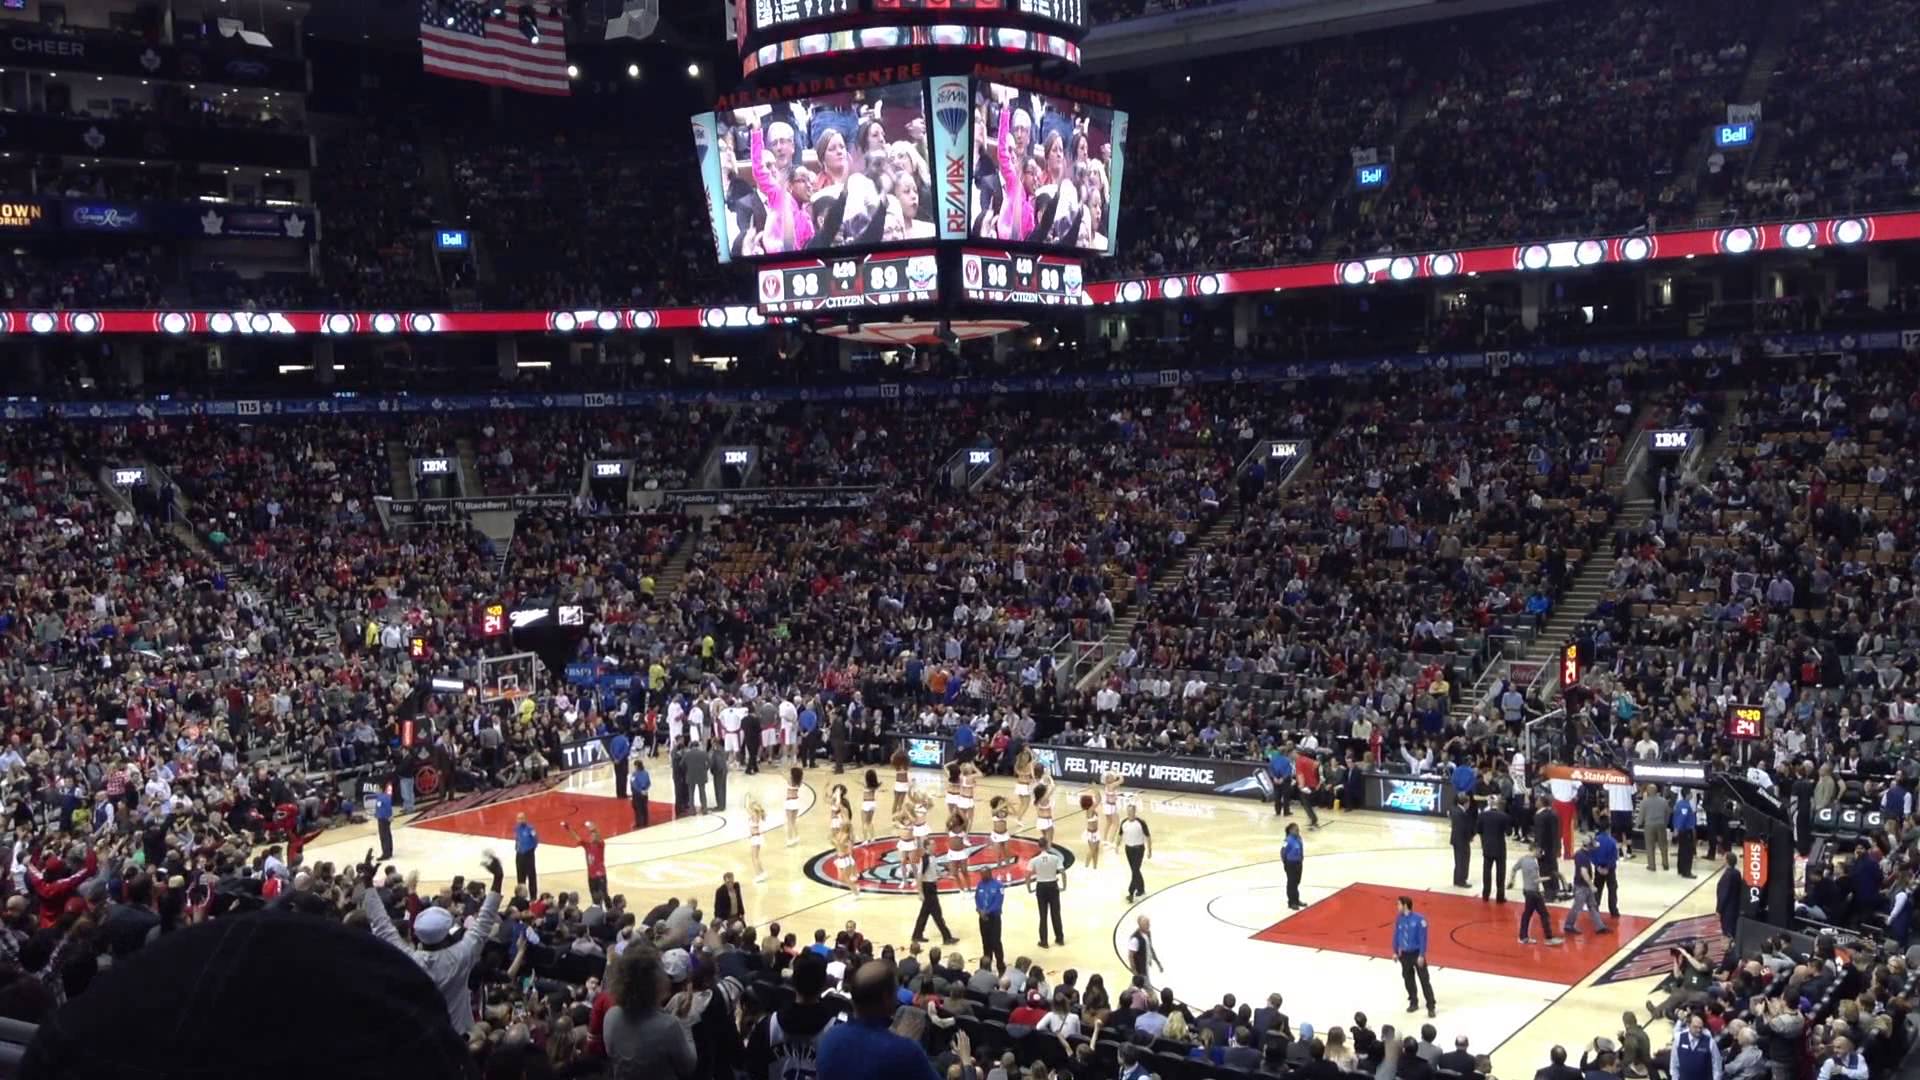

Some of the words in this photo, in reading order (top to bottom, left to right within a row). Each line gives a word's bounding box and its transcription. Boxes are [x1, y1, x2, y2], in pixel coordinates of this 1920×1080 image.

[12, 38, 84, 56] CHEER
[715, 90, 752, 110] AIR
[756, 78, 836, 101] CANADA
[844, 63, 922, 88] CENTRE
[1721, 126, 1746, 143] Bell
[1361, 169, 1381, 183] Bell
[945, 153, 967, 232] RE/MAX
[442, 233, 461, 245] Bell
[792, 273, 819, 296] 98
[871, 265, 898, 290] 89
[825, 295, 864, 309] CITIZEN
[239, 401, 258, 414] 115
[585, 395, 604, 406] 116
[1655, 432, 1687, 447] IBM
[969, 451, 990, 463] IBM
[1271, 443, 1297, 457] IBM
[725, 451, 748, 464] IBM
[422, 460, 448, 472] IBM
[596, 463, 621, 475] IBM
[116, 471, 142, 484] IBM
[485, 616, 500, 632] 24
[1736, 719, 1755, 734] 24
[1065, 757, 1088, 773] FEEL
[1089, 759, 1110, 774] THE
[1111, 761, 1147, 778] FLEX4
[1149, 764, 1215, 785] DIFFERENCE.
[1819, 808, 1831, 821] G
[1843, 810, 1856, 822] G
[1868, 812, 1881, 825] G
